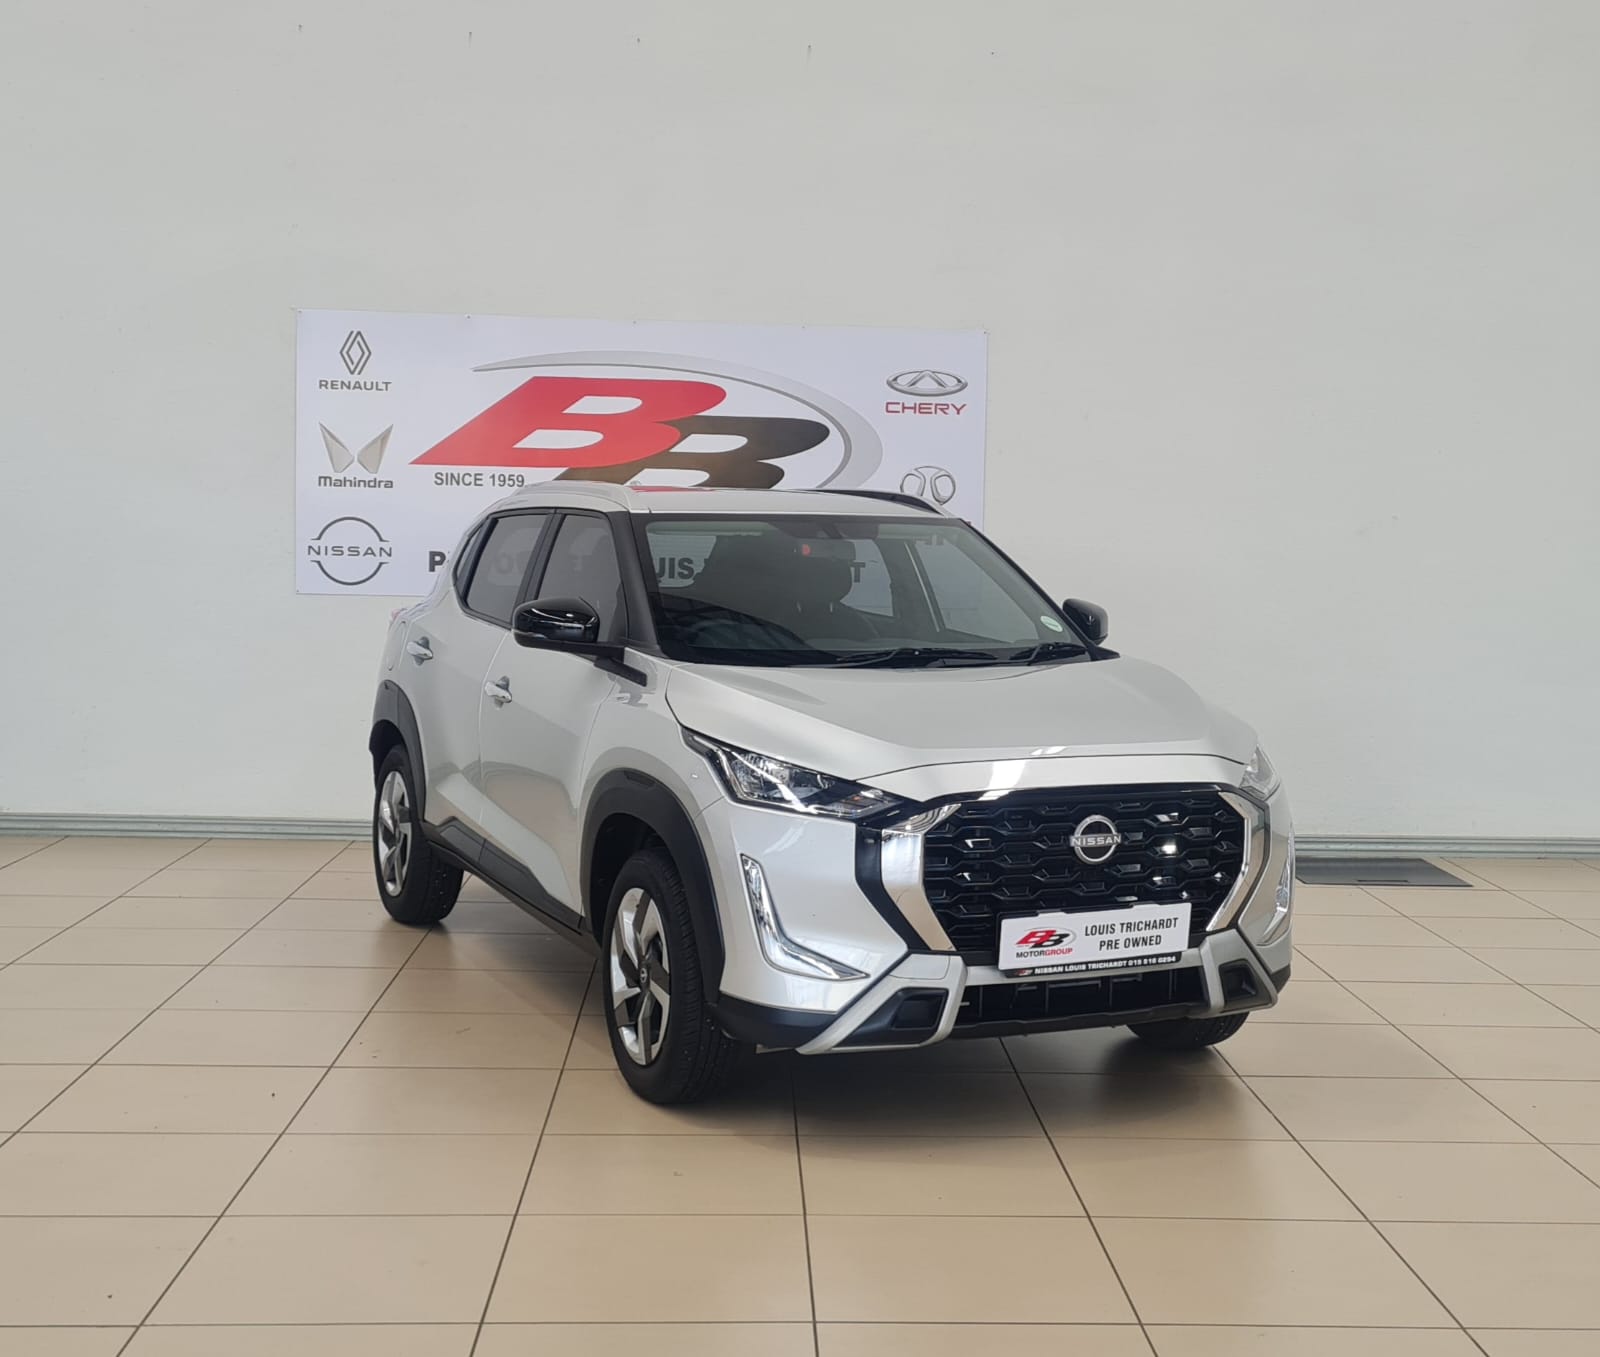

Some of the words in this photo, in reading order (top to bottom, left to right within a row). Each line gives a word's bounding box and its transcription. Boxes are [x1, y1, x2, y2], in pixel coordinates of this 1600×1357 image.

[318, 379, 392, 391] RENAULT
[885, 402, 967, 415] CHERY
[318, 475, 393, 489] Mahindra
[434, 472, 484, 487] SINCE
[488, 474, 525, 488] 1959
[307, 545, 392, 557] NISSAN
[1072, 835, 1121, 847] NISSAN
[1085, 923, 1116, 936] LOUIS
[1120, 917, 1179, 933] TRICHARDT
[1099, 939, 1120, 951] PRE
[1123, 935, 1162, 949] OWNED
[1016, 947, 1073, 958] MOTORGROUP
[1034, 967, 1063, 975] NISSAN
[1064, 964, 1086, 972] LOUIS
[1087, 960, 1127, 970] TRICHARDT
